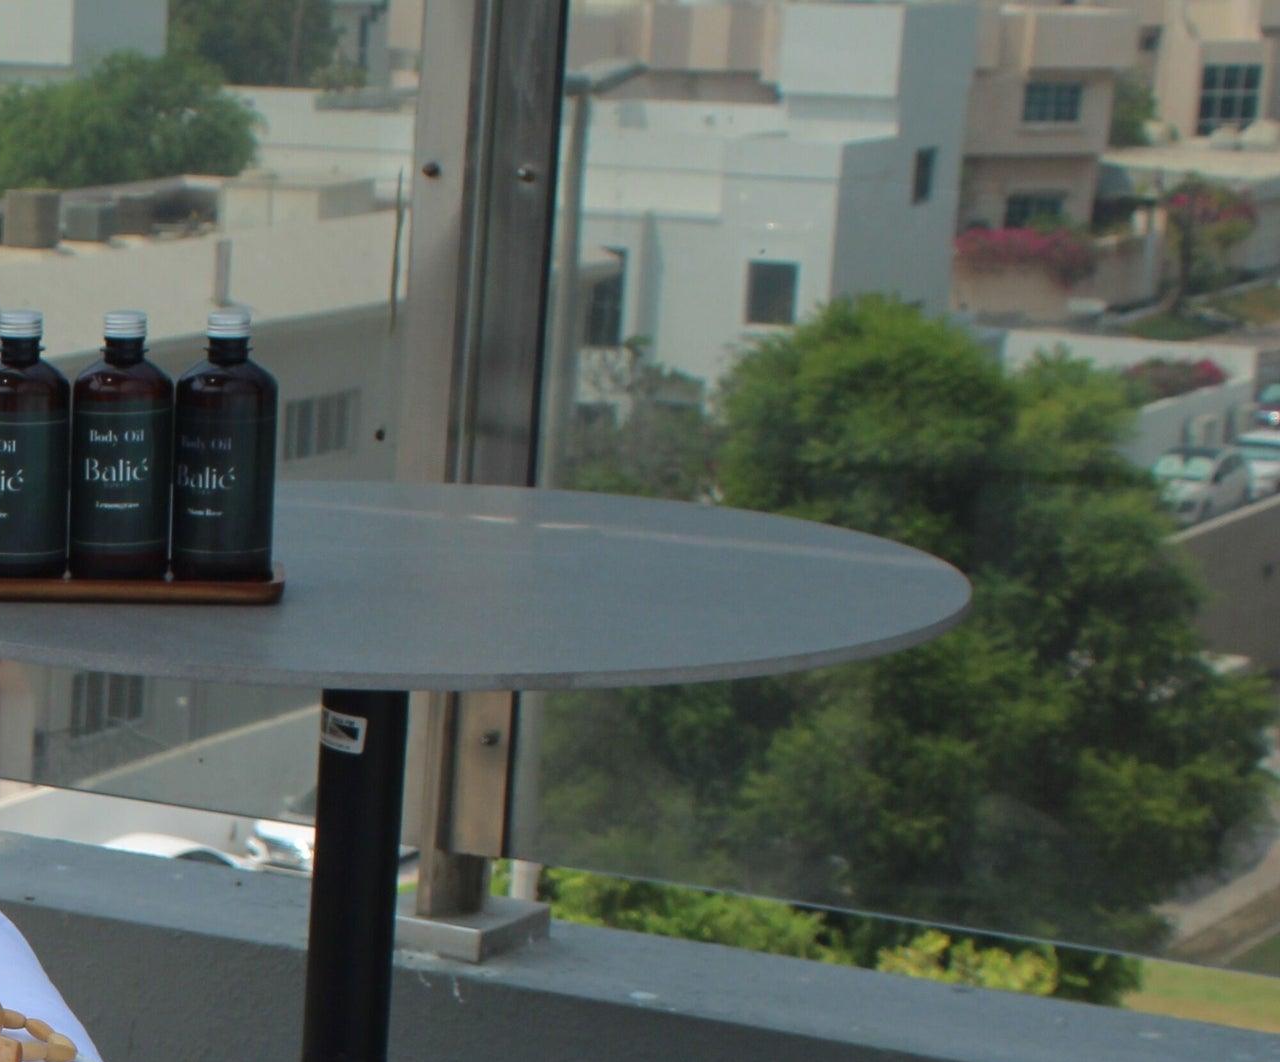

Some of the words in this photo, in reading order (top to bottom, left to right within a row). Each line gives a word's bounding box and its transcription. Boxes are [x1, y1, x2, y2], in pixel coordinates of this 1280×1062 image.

[90, 429, 120, 447] Body
[124, 429, 144, 442] Oil
[181, 436, 205, 453] Body
[211, 438, 232, 451] Oil
